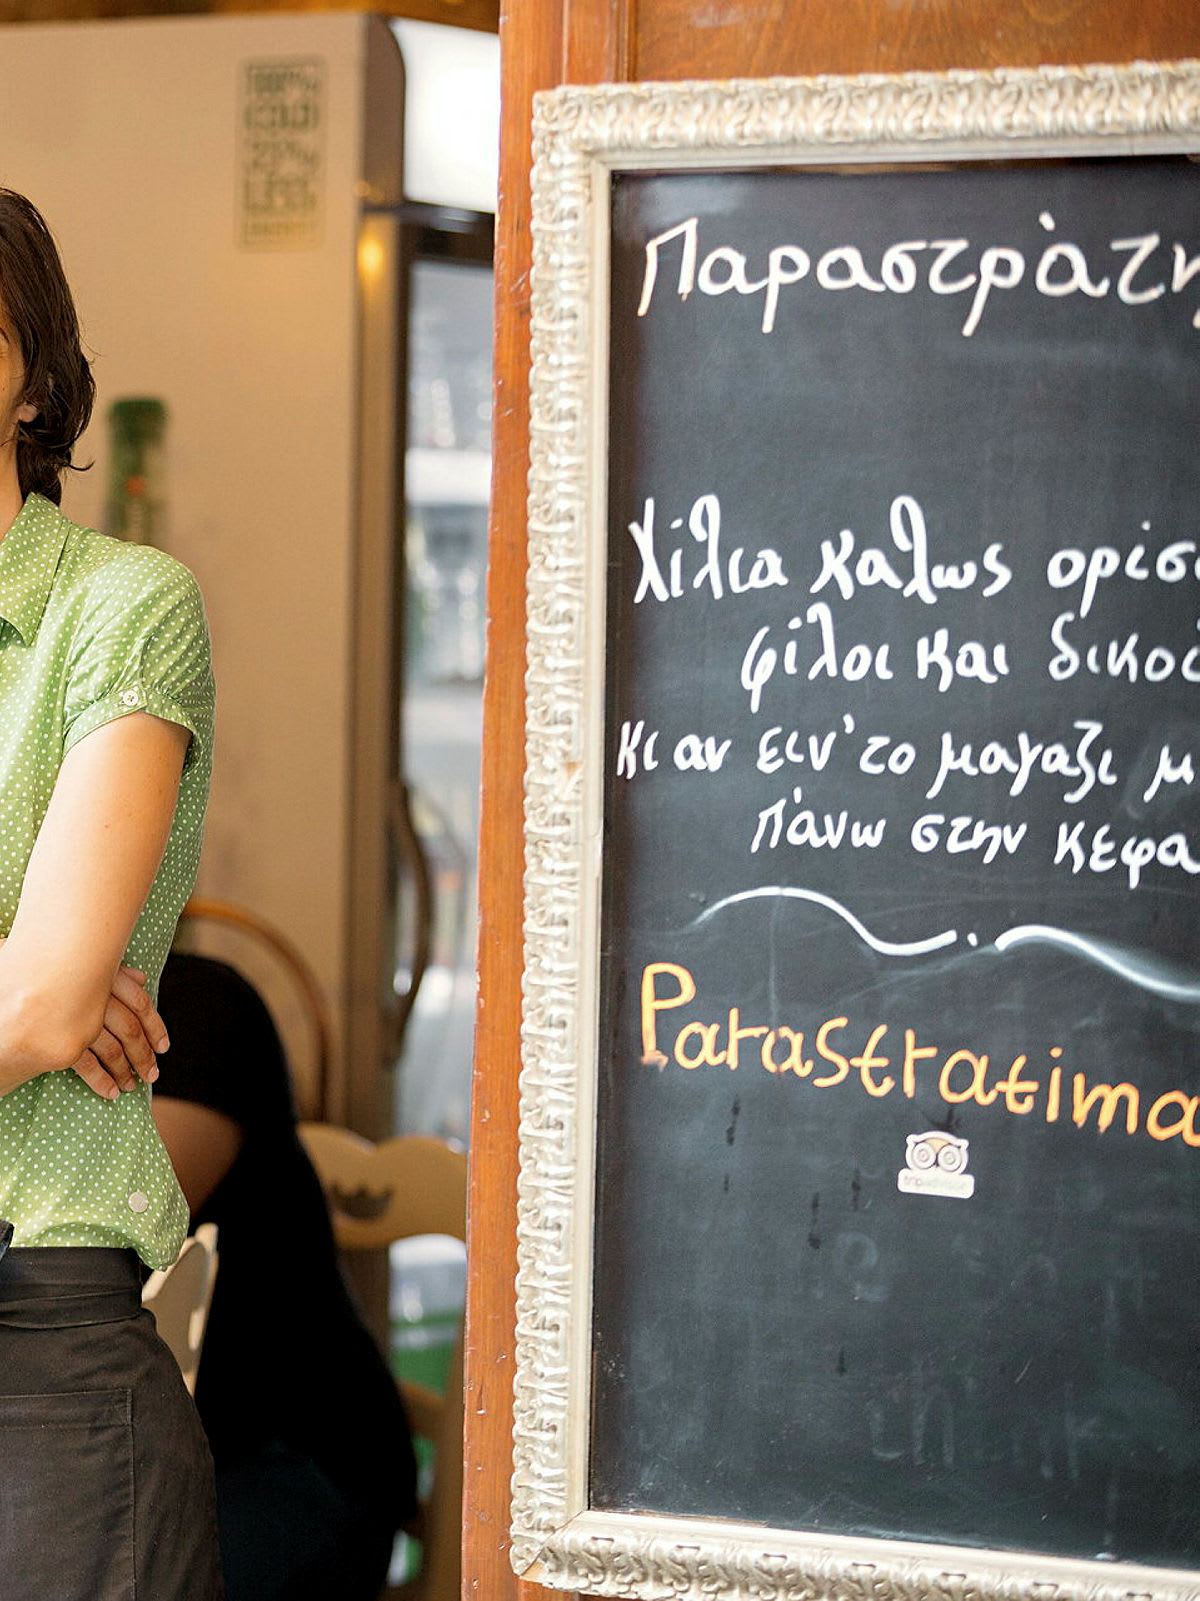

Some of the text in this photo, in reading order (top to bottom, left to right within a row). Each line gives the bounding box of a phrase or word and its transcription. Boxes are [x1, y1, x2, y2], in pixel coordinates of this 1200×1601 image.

[1046, 520, 1200, 619] ορίσ
[740, 601, 894, 714] φίλοι
[916, 627, 1010, 693] και
[673, 733, 733, 773] αν
[925, 720, 1118, 804] μαγαζι
[910, 813, 1028, 864] στην
